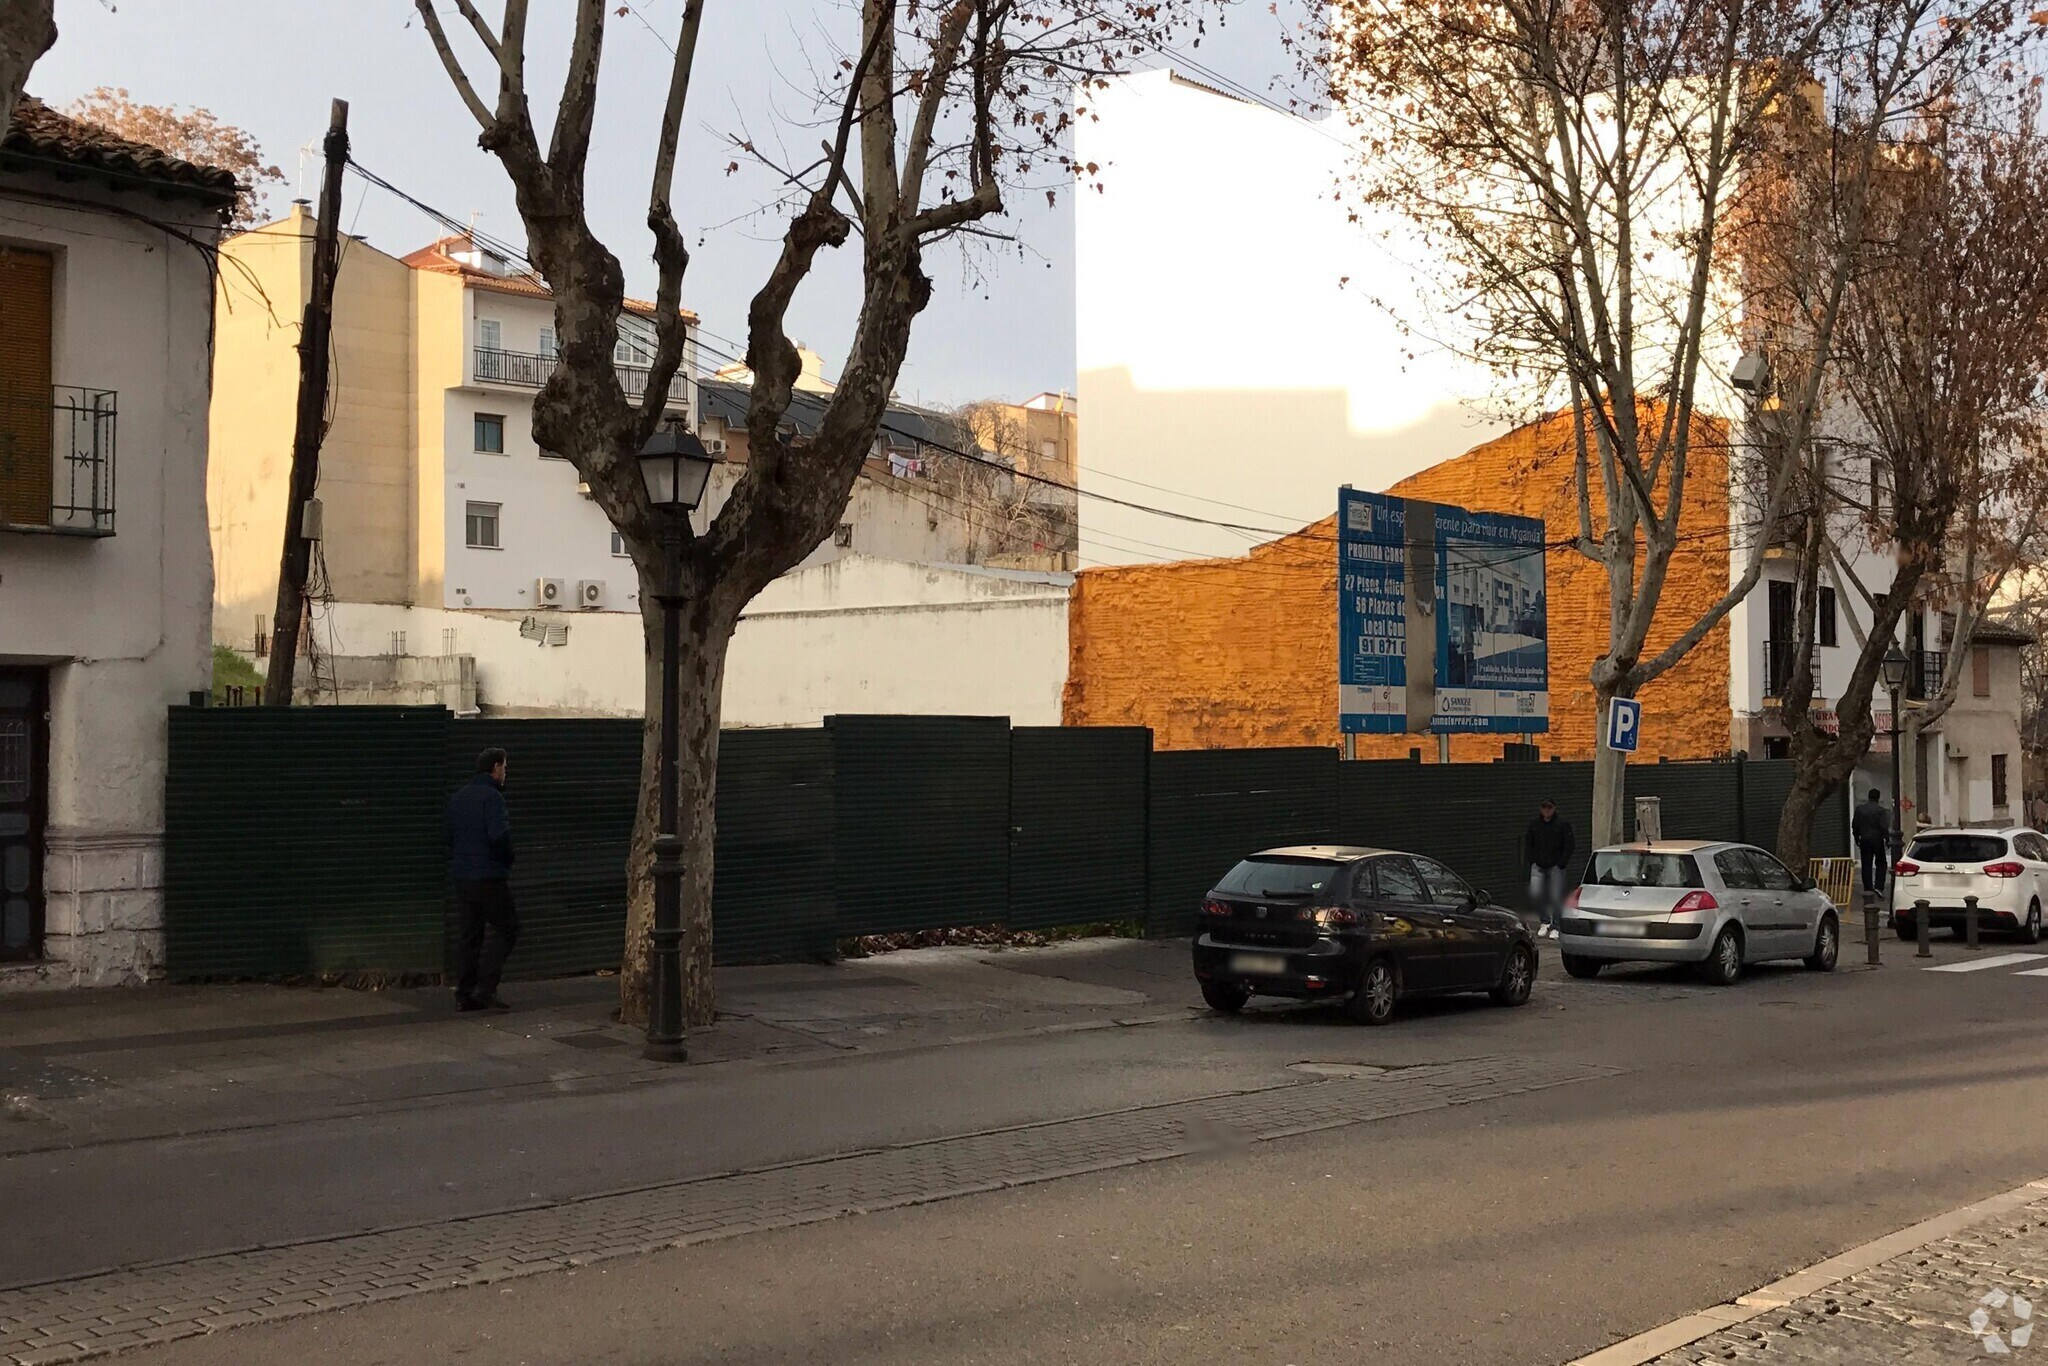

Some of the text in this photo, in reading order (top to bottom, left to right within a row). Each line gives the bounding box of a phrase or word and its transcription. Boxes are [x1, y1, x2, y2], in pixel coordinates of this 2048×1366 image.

[1461, 520, 1481, 536] para
[1499, 527, 1509, 539] en
[1344, 574, 1355, 591] 27
[1355, 597, 1367, 614] 56
[1368, 598, 1395, 615] Plazas
[1363, 618, 1386, 636] Local
[1361, 638, 1373, 653] 91
[1378, 638, 1397, 655] 871
[1615, 705, 1635, 743] P
